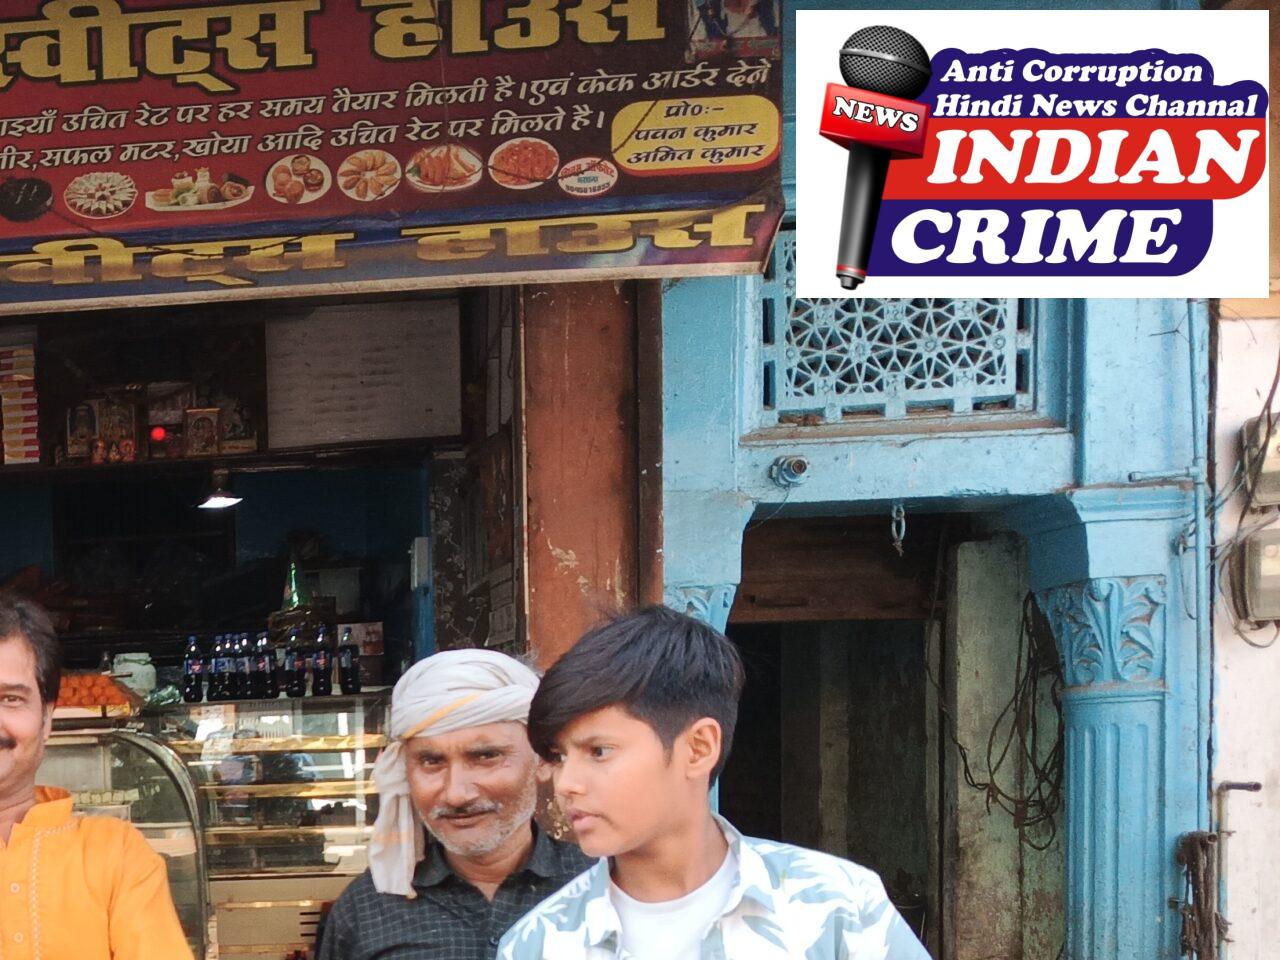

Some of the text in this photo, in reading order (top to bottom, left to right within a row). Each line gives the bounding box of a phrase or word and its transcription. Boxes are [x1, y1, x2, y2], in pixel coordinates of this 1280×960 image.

[361, 0, 666, 58] हाउस
[62, 106, 129, 131] उचित
[135, 102, 171, 126] रेट
[176, 104, 211, 123] पर
[218, 101, 254, 122] हर
[259, 96, 326, 118] समय
[331, 87, 399, 113] तैयार
[405, 77, 488, 107] मिलती
[577, 68, 637, 94] केक
[642, 62, 720, 91] आर्डर
[725, 58, 772, 86] देने
[257, 124, 324, 151] आदि
[330, 121, 399, 147] उचित
[405, 116, 441, 141] रेट
[448, 118, 485, 138] पर
[490, 106, 566, 136] मिलते
[633, 123, 758, 142] पवन कुमार
[626, 144, 766, 164] अमित कुमार
